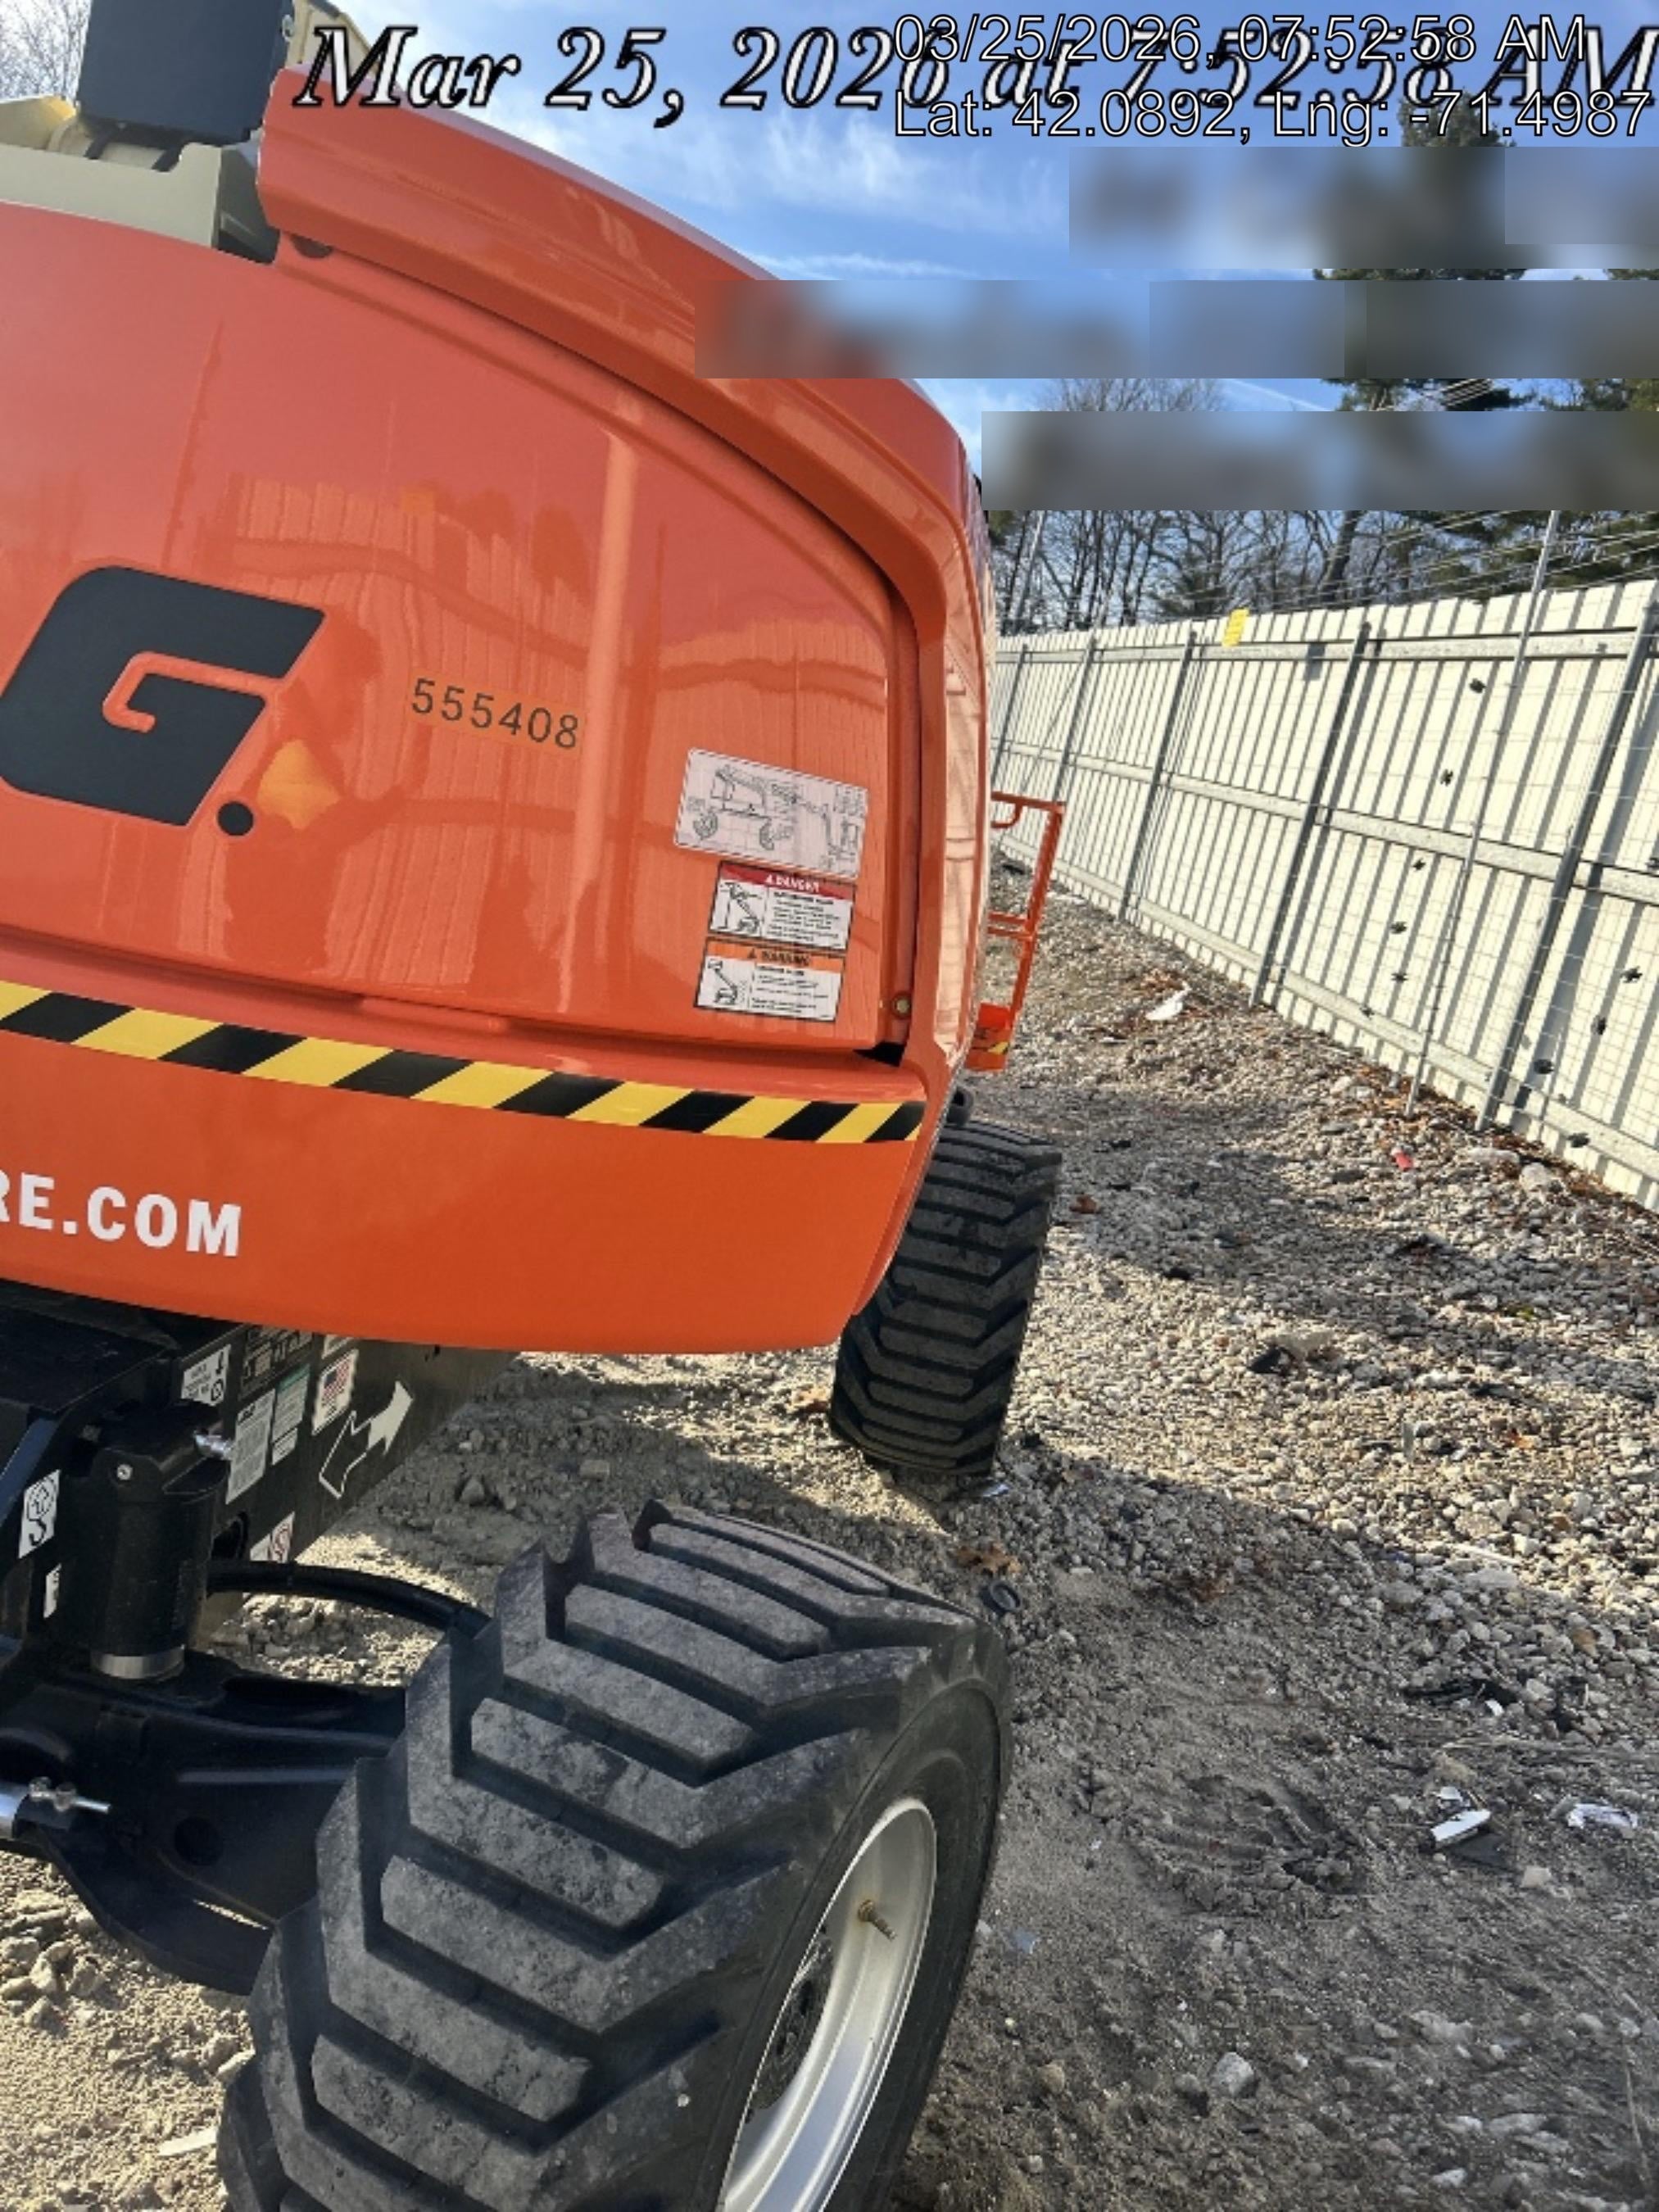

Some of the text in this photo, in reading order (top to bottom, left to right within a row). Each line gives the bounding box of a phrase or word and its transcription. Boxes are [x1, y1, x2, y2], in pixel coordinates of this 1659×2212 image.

[0, 565, 325, 826] G
[412, 678, 578, 749] 555408
[0, 1169, 242, 1257] E.COM
